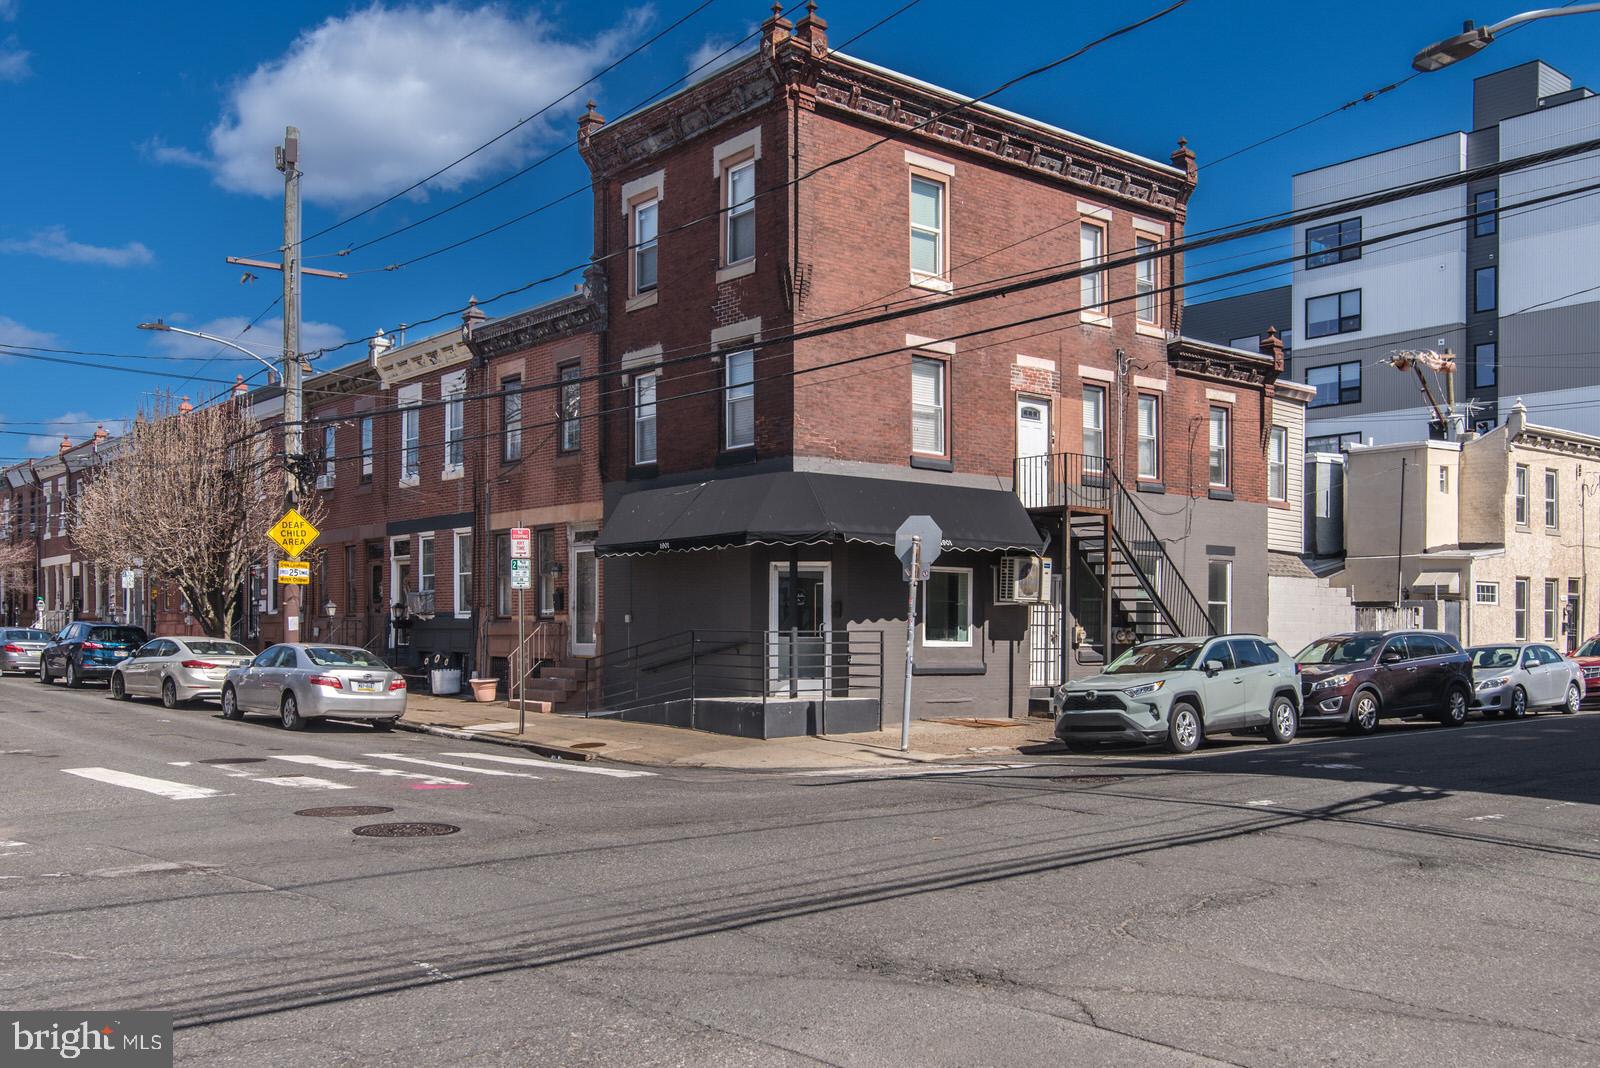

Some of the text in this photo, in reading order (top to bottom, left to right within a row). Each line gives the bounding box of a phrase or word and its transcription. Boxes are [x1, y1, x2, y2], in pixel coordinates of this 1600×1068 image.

[282, 521, 305, 529] DEAF
[513, 560, 517, 569] 2
[289, 568, 299, 576] 25
